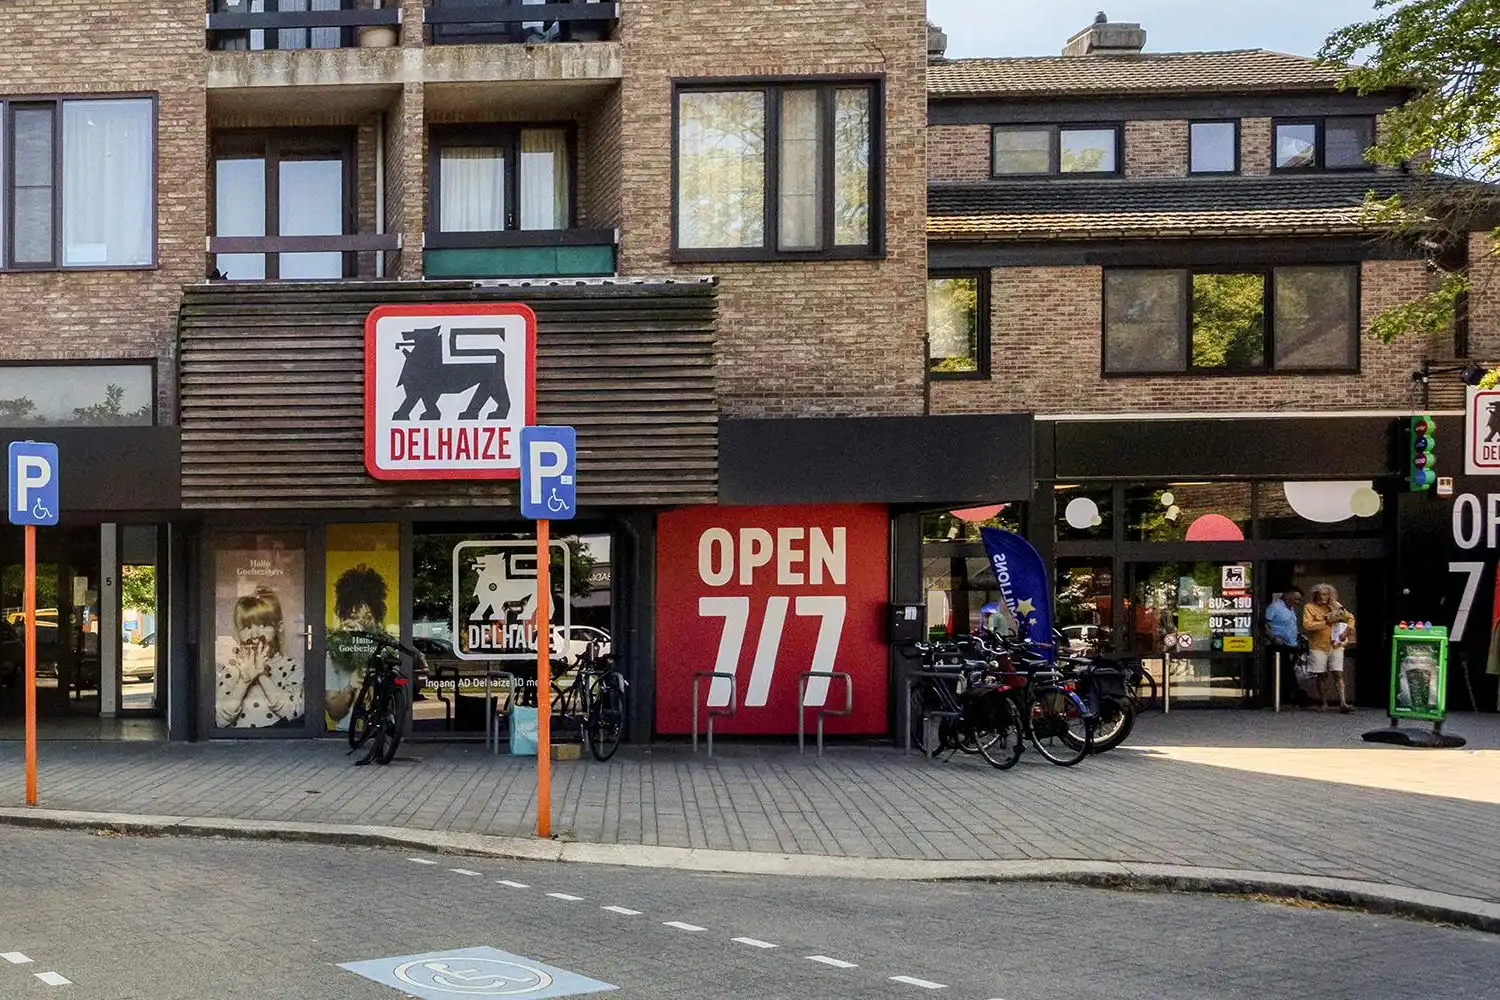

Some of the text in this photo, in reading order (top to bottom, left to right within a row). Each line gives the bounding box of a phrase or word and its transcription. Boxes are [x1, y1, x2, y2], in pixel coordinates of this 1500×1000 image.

[390, 427, 512, 461] DELHAIZE
[17, 455, 51, 511] P
[530, 441, 568, 504] P
[106, 577, 112, 586] 5
[698, 526, 847, 587] OPEN
[699, 595, 847, 706] 7/7
[425, 679, 456, 690] Ingang
[458, 678, 471, 687] AD
[526, 679, 553, 687] mer
